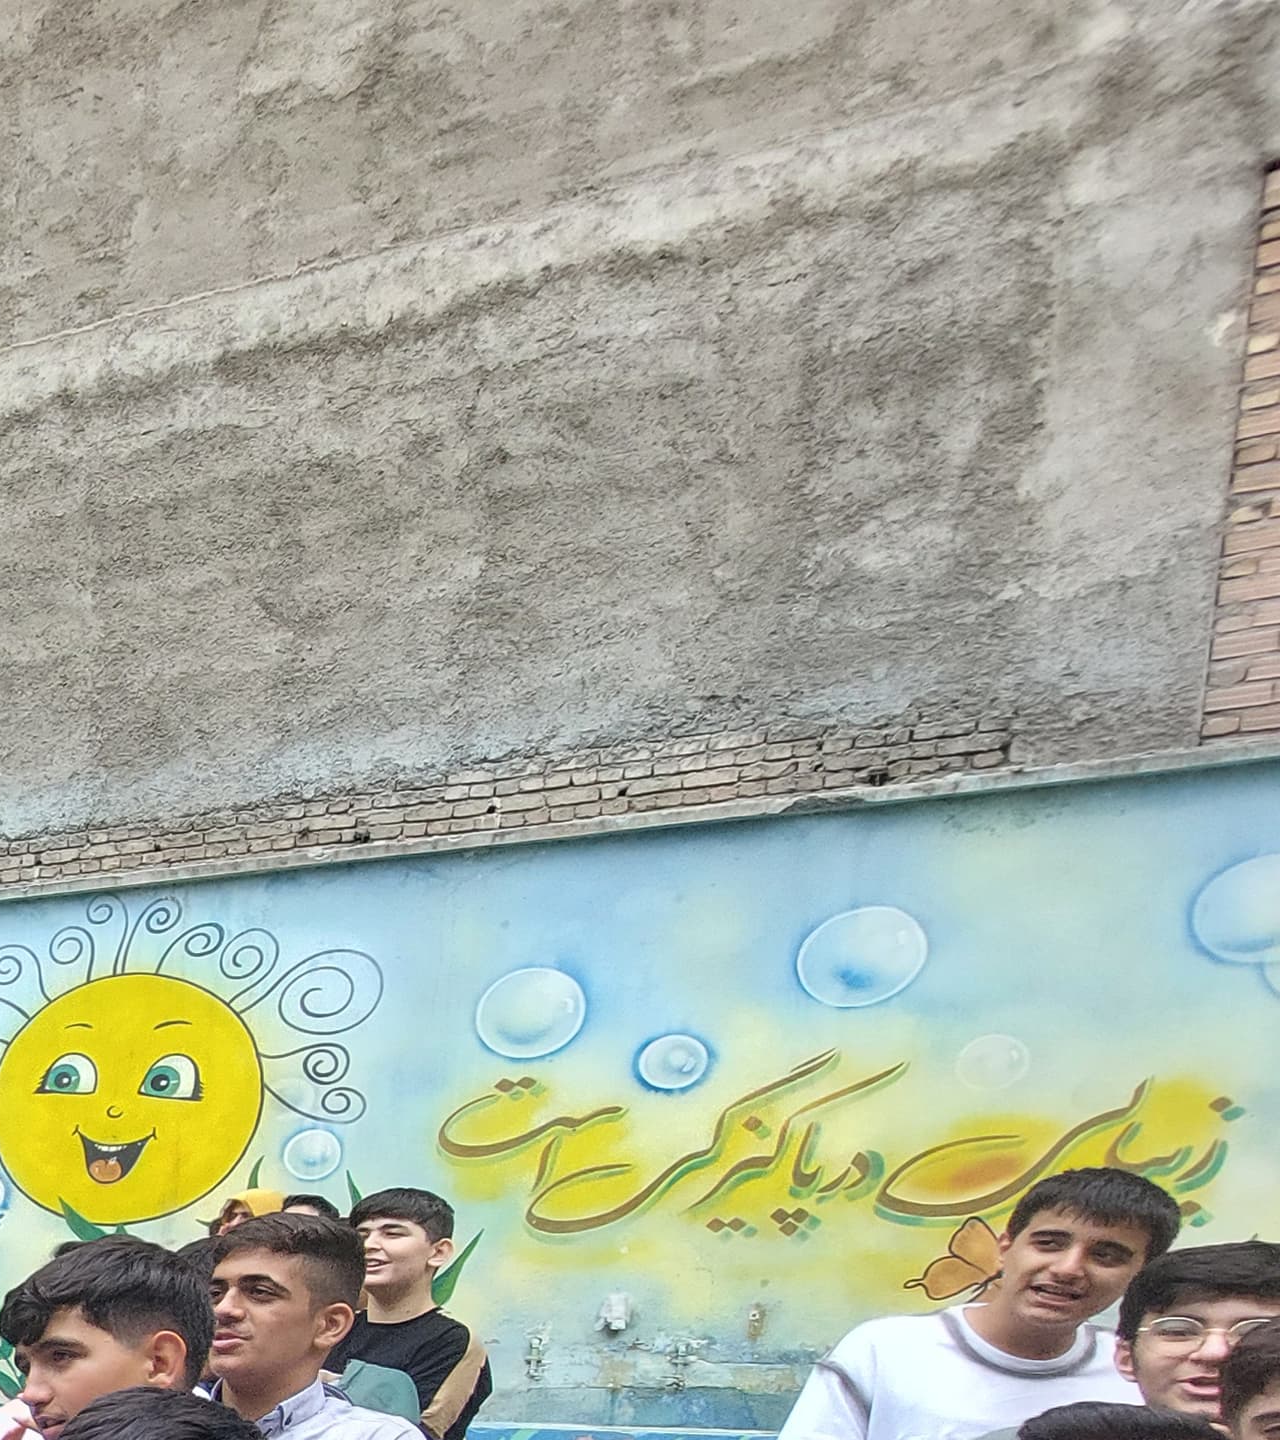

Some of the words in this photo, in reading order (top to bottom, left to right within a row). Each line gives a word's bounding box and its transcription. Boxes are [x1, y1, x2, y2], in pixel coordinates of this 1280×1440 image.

[438, 1077, 624, 1192] است
[526, 1048, 905, 1240] پاکیزگی
[816, 1151, 875, 1201] در
